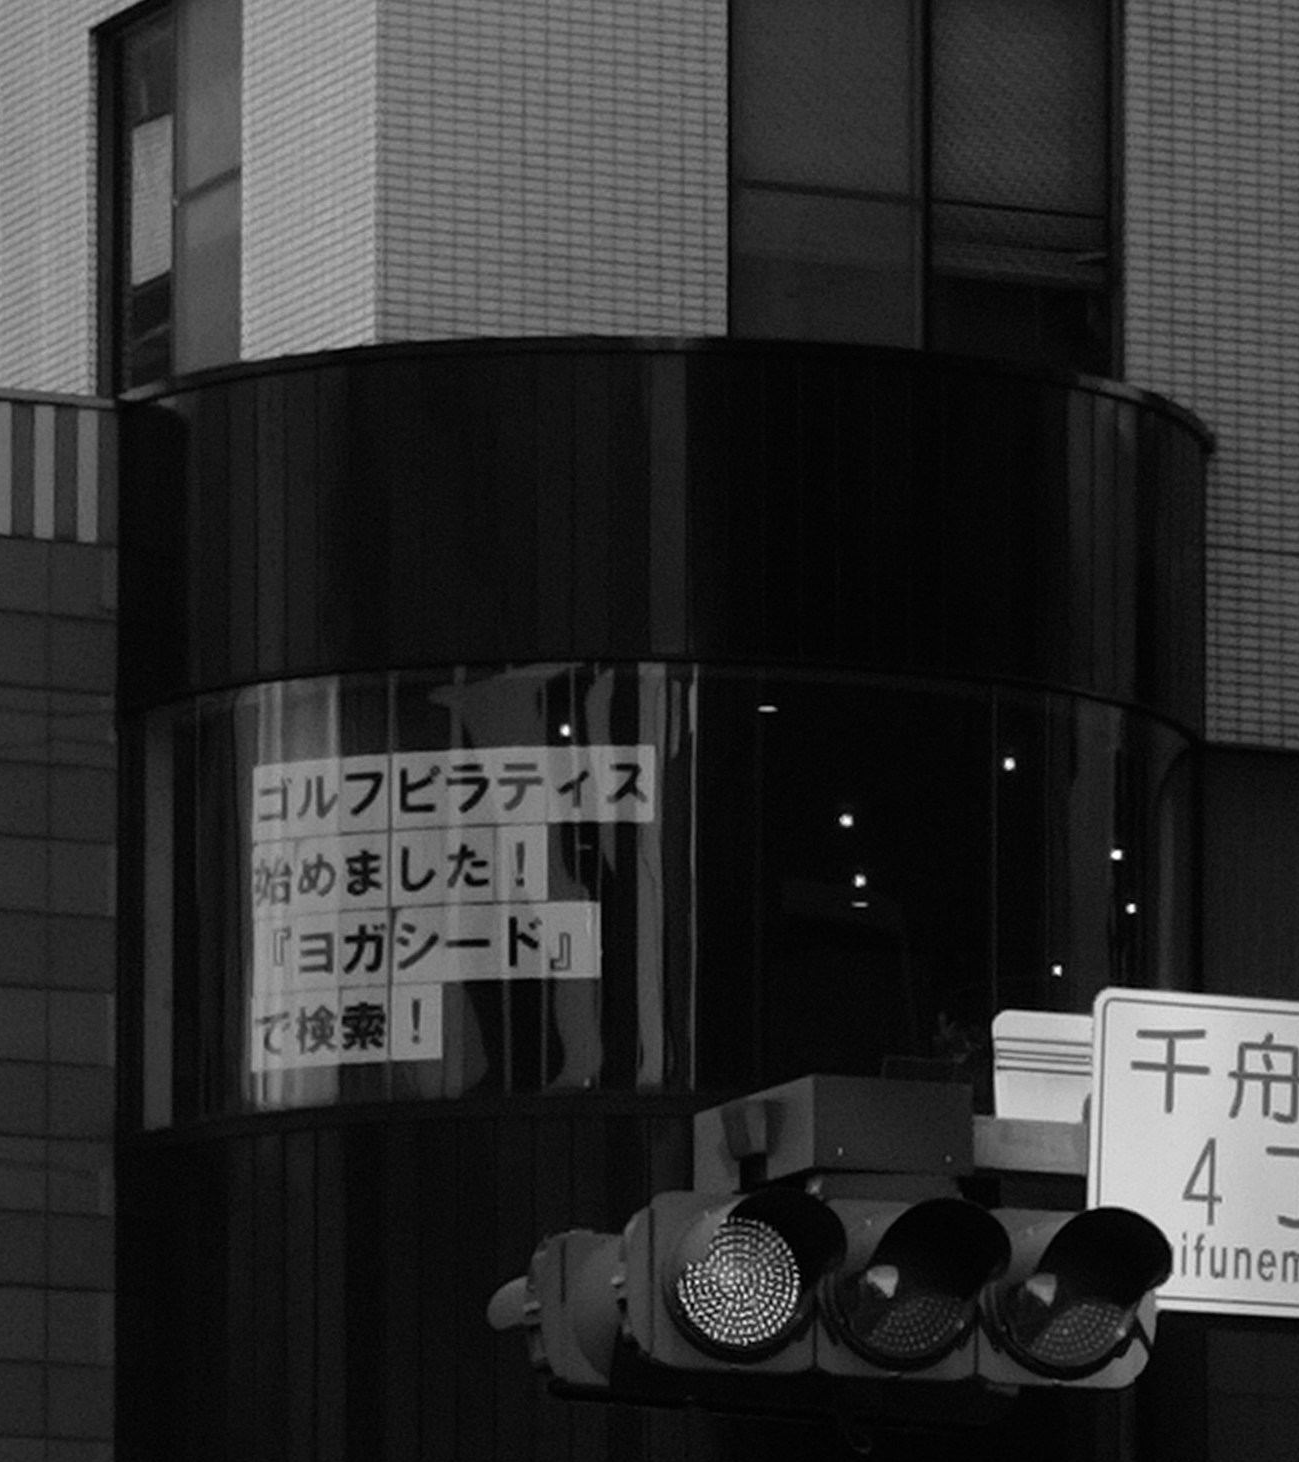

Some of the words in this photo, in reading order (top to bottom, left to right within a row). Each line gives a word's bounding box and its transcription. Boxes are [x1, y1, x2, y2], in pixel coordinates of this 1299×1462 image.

[256, 762, 649, 823] ゴルフピラティス
[253, 840, 528, 906] 始めました！
[269, 914, 572, 977] 『ヨガシード』
[255, 998, 424, 1056] で検索！
